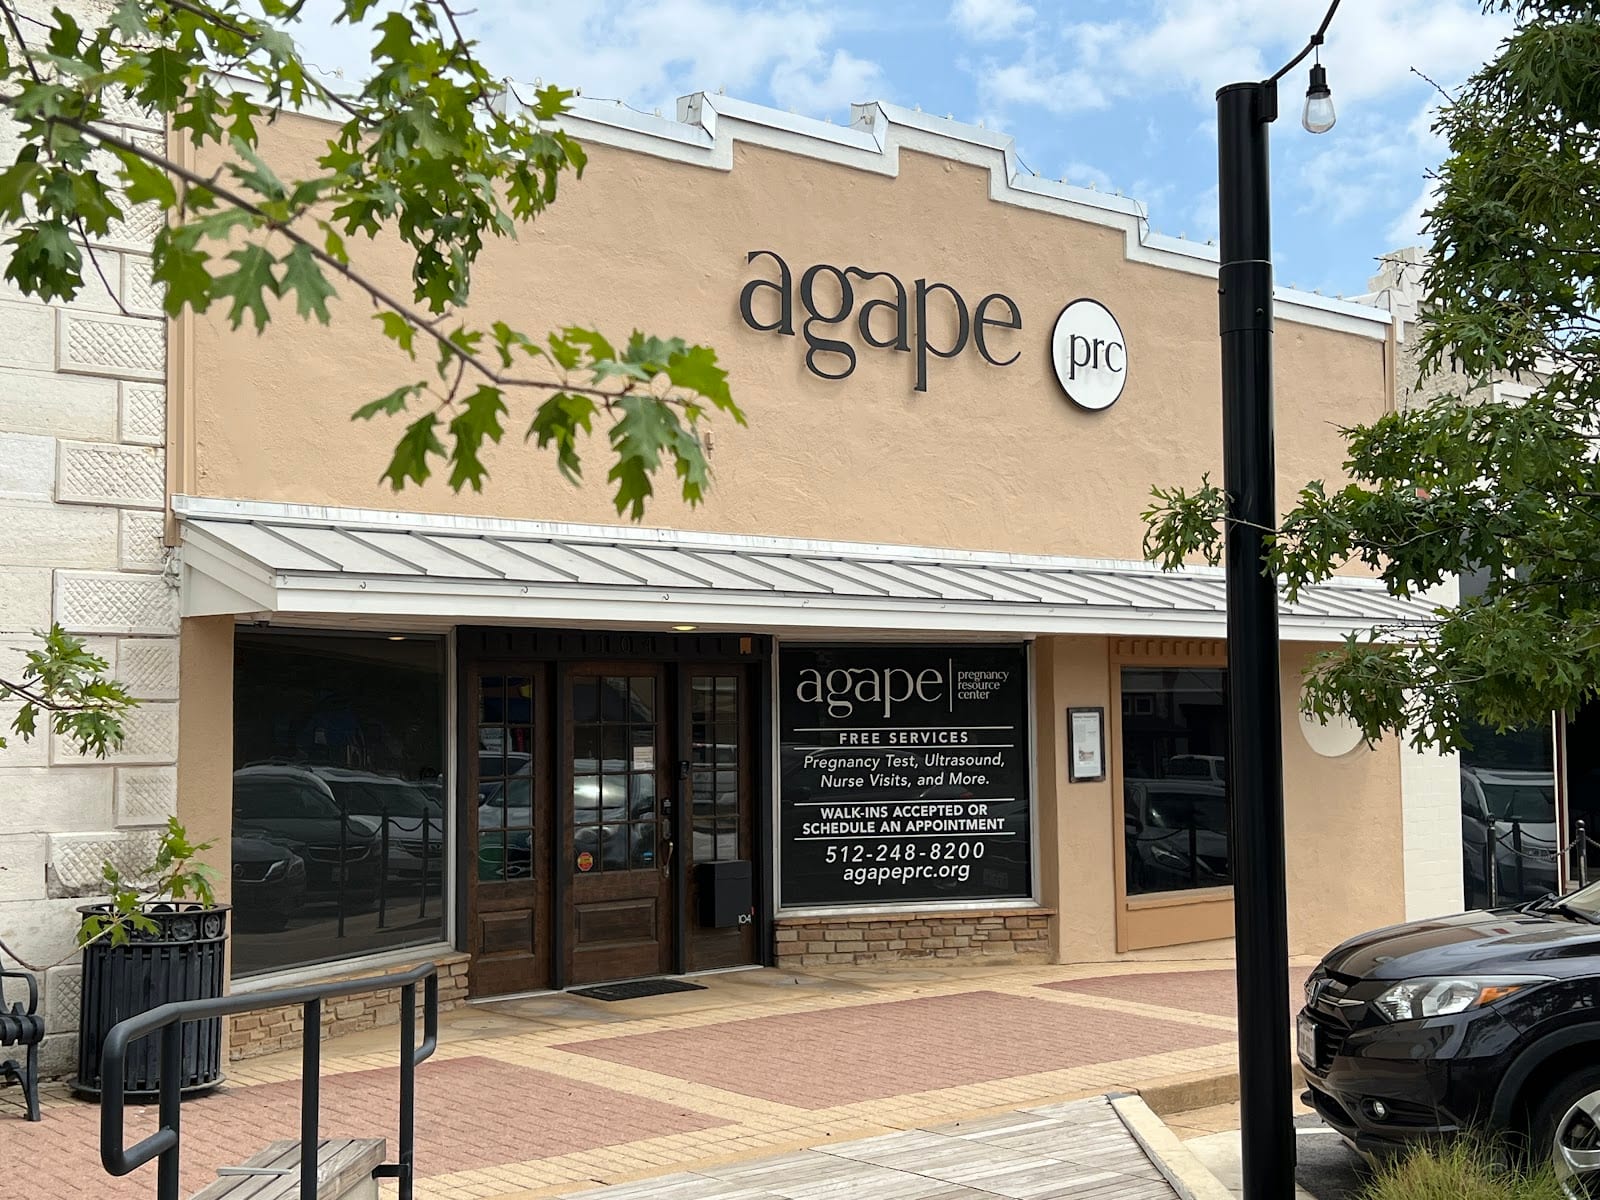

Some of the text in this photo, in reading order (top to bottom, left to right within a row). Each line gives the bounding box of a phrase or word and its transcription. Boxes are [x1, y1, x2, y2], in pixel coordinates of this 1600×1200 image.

[740, 251, 1022, 392] agape
[1069, 333, 1123, 380] prc
[957, 670, 1009, 682] pregnancy
[796, 667, 943, 718] agape
[957, 681, 1001, 690] resource
[957, 690, 991, 700] center
[840, 732, 967, 744] FREE SERVICES
[804, 752, 1004, 771] Pregnancy Test, Ultrasound,
[821, 772, 989, 787] Nurse Visits, and More.
[821, 804, 987, 819] WALK-INS ACCEPTED OR
[803, 818, 1005, 834] SCHEDULE AN APPOINTMENT
[826, 842, 984, 863] 512-248-8200
[844, 865, 969, 885] agapeprc.org
[738, 914, 753, 925] 104
